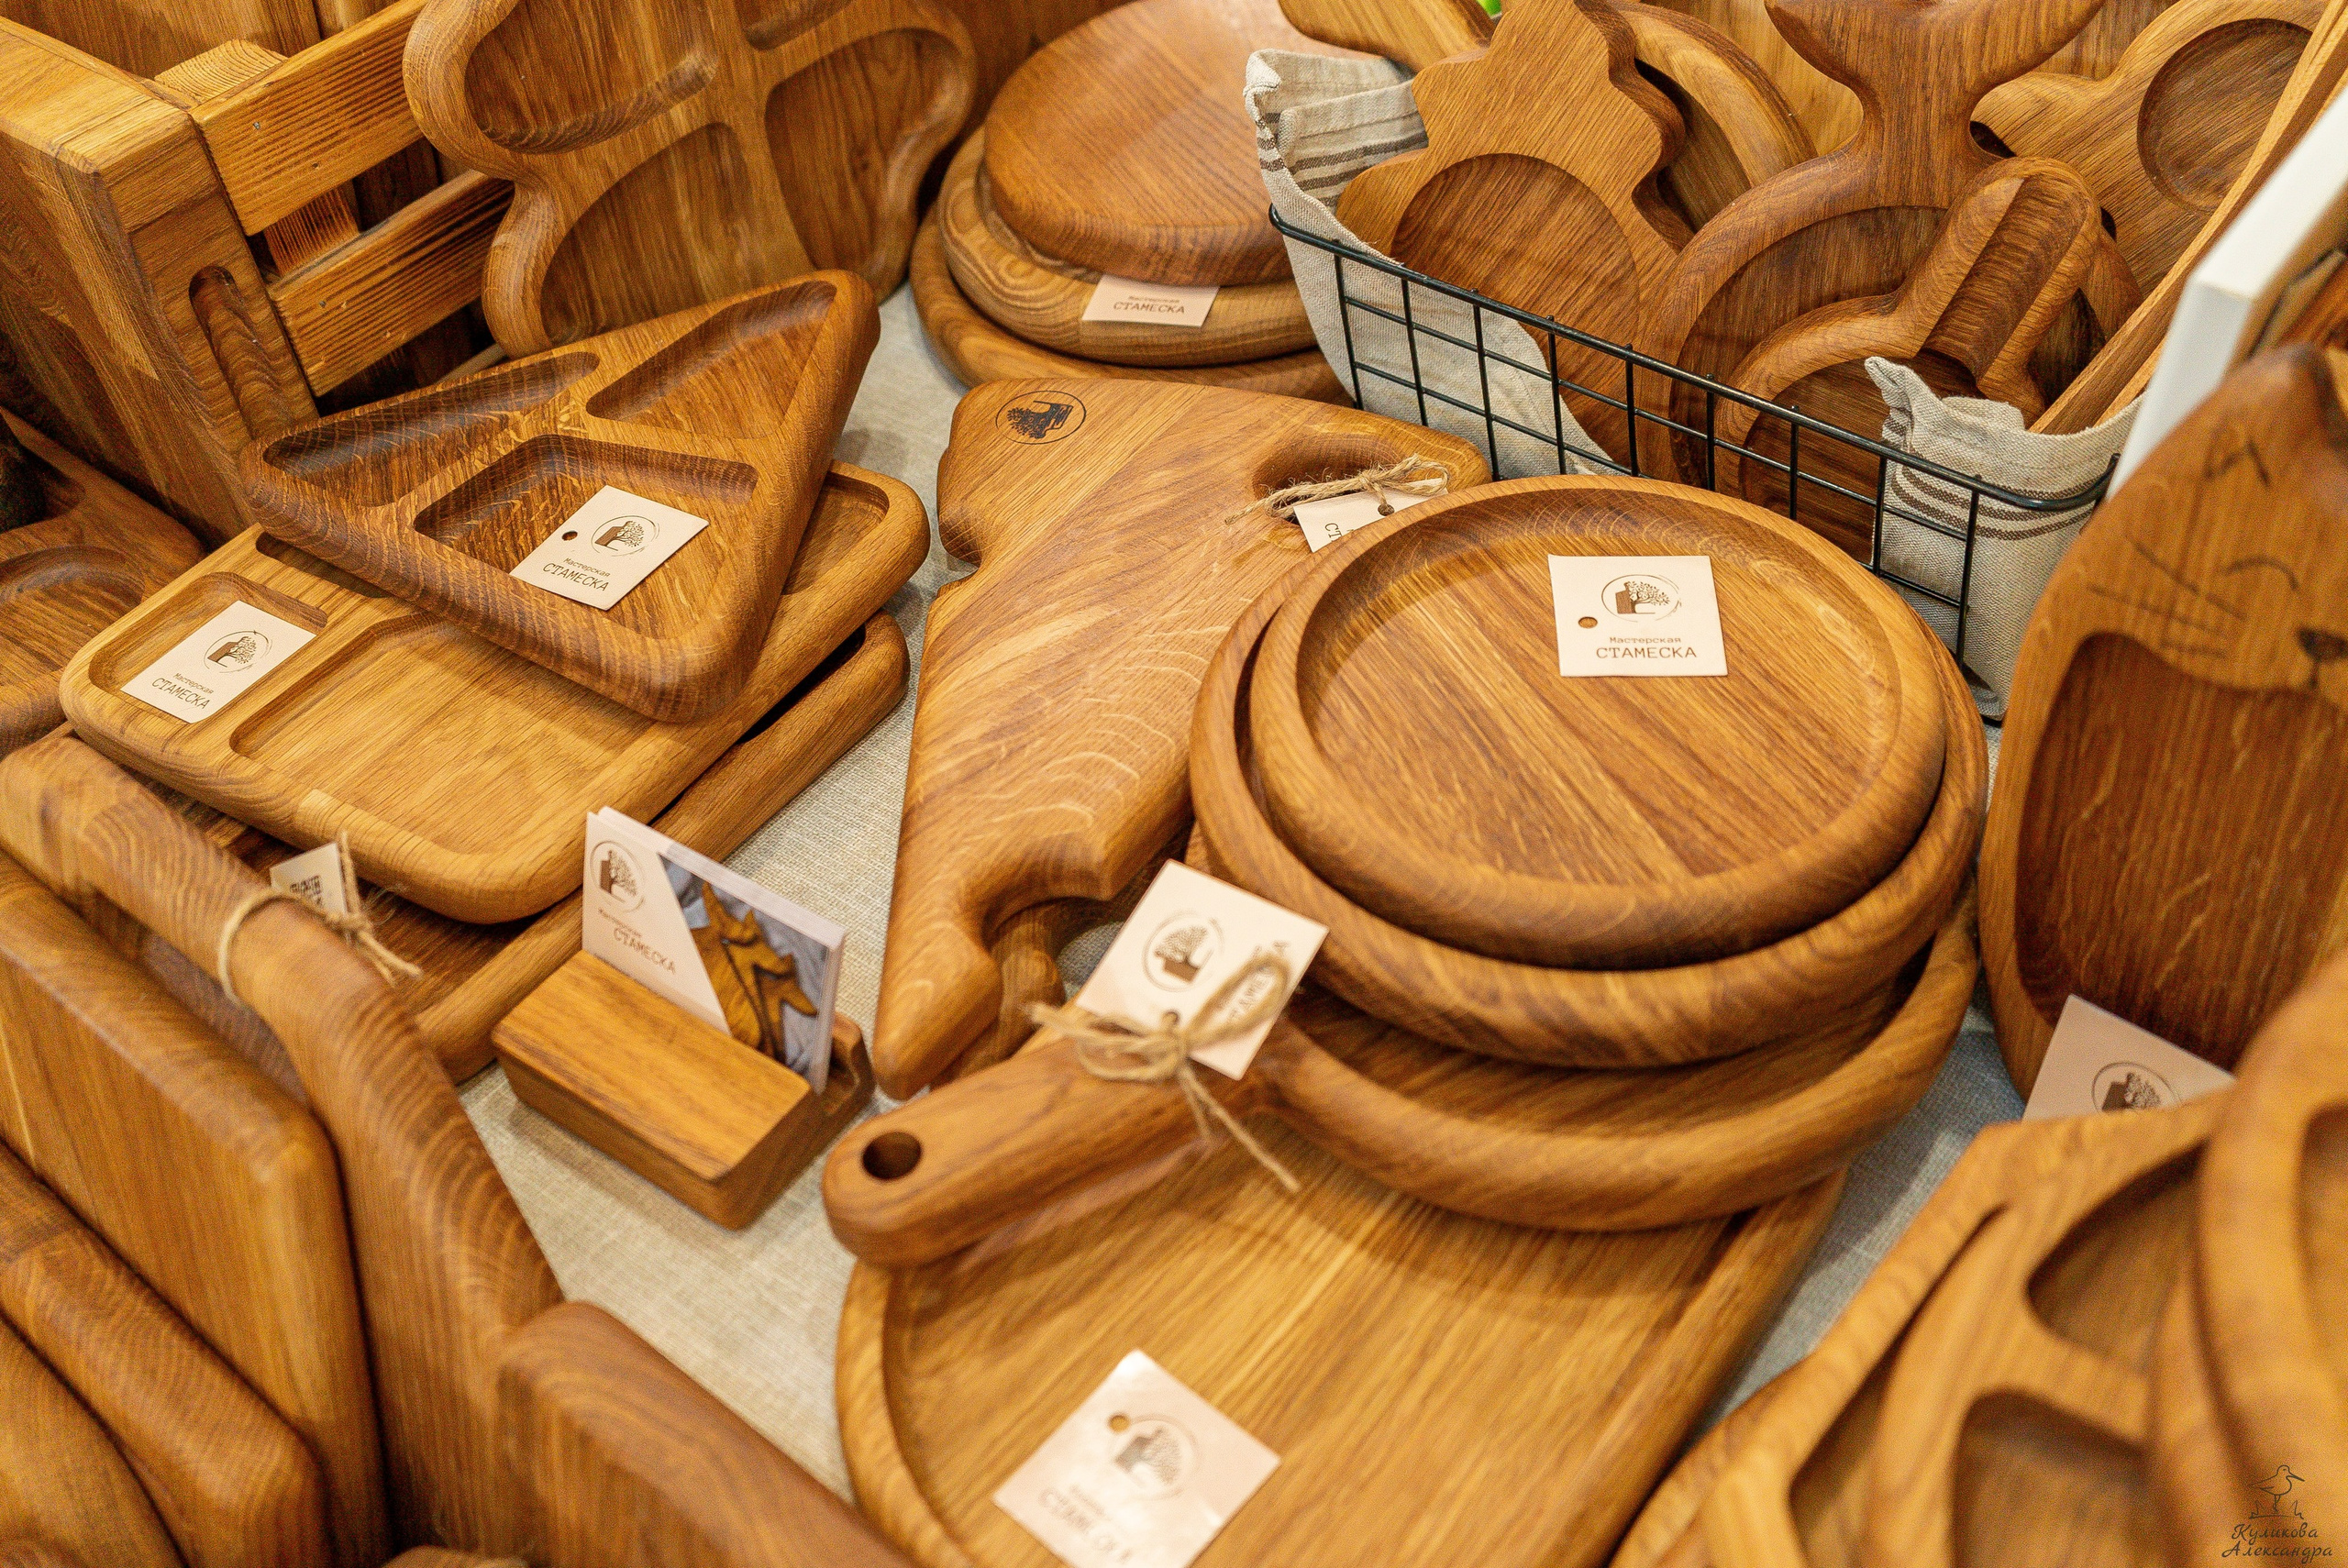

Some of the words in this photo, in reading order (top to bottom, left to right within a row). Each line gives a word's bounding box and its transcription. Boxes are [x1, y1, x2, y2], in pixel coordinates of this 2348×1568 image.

[1113, 301, 1185, 314] СТАМЕСКА
[543, 562, 610, 591] СТАМЕСКА
[563, 558, 611, 578] Мастерская
[1596, 647, 1697, 659] СТАМЕСКА
[151, 677, 211, 710] СТАМЕСКА
[172, 672, 215, 695] Мастерская
[614, 927, 676, 975] СТАМЕСКА
